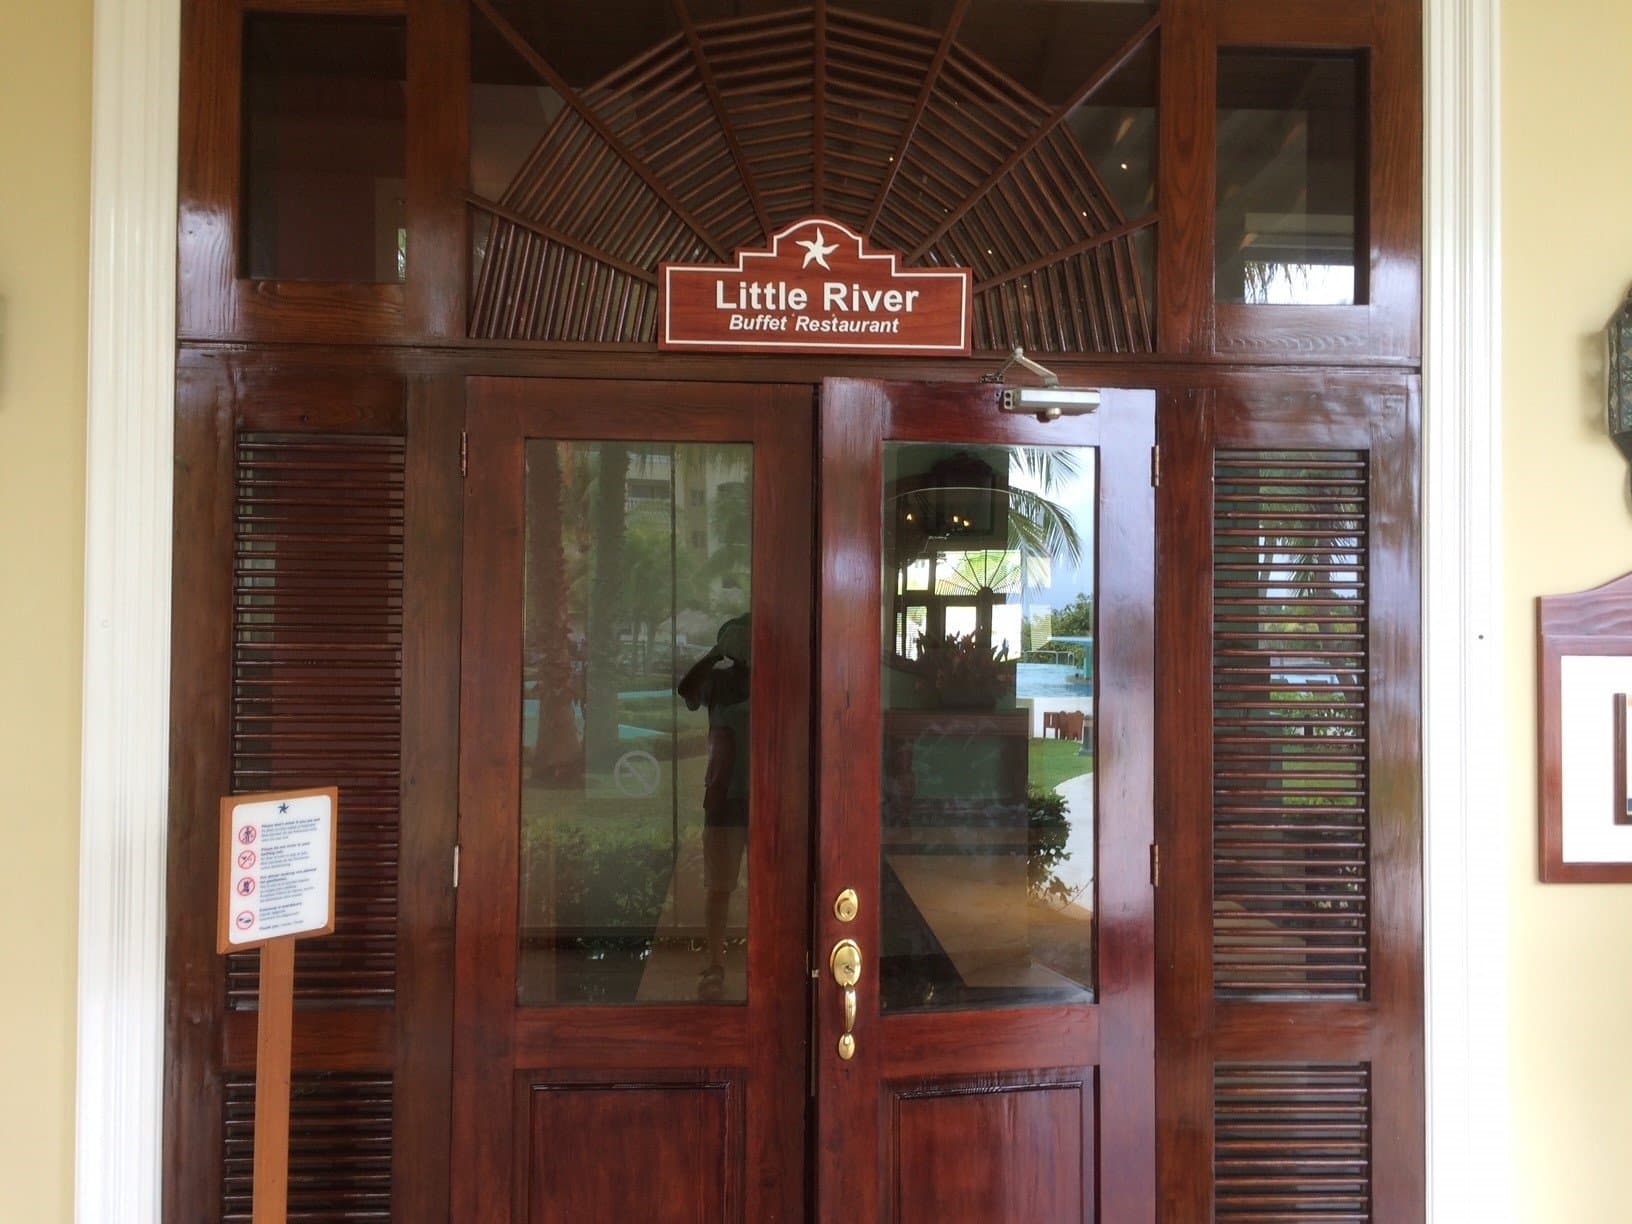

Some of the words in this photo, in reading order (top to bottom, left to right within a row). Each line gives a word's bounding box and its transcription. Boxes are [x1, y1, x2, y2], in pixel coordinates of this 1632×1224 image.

[715, 280, 808, 311] Little
[823, 282, 920, 313] River
[729, 314, 788, 331] Buffet
[795, 315, 900, 334] Restaurant
